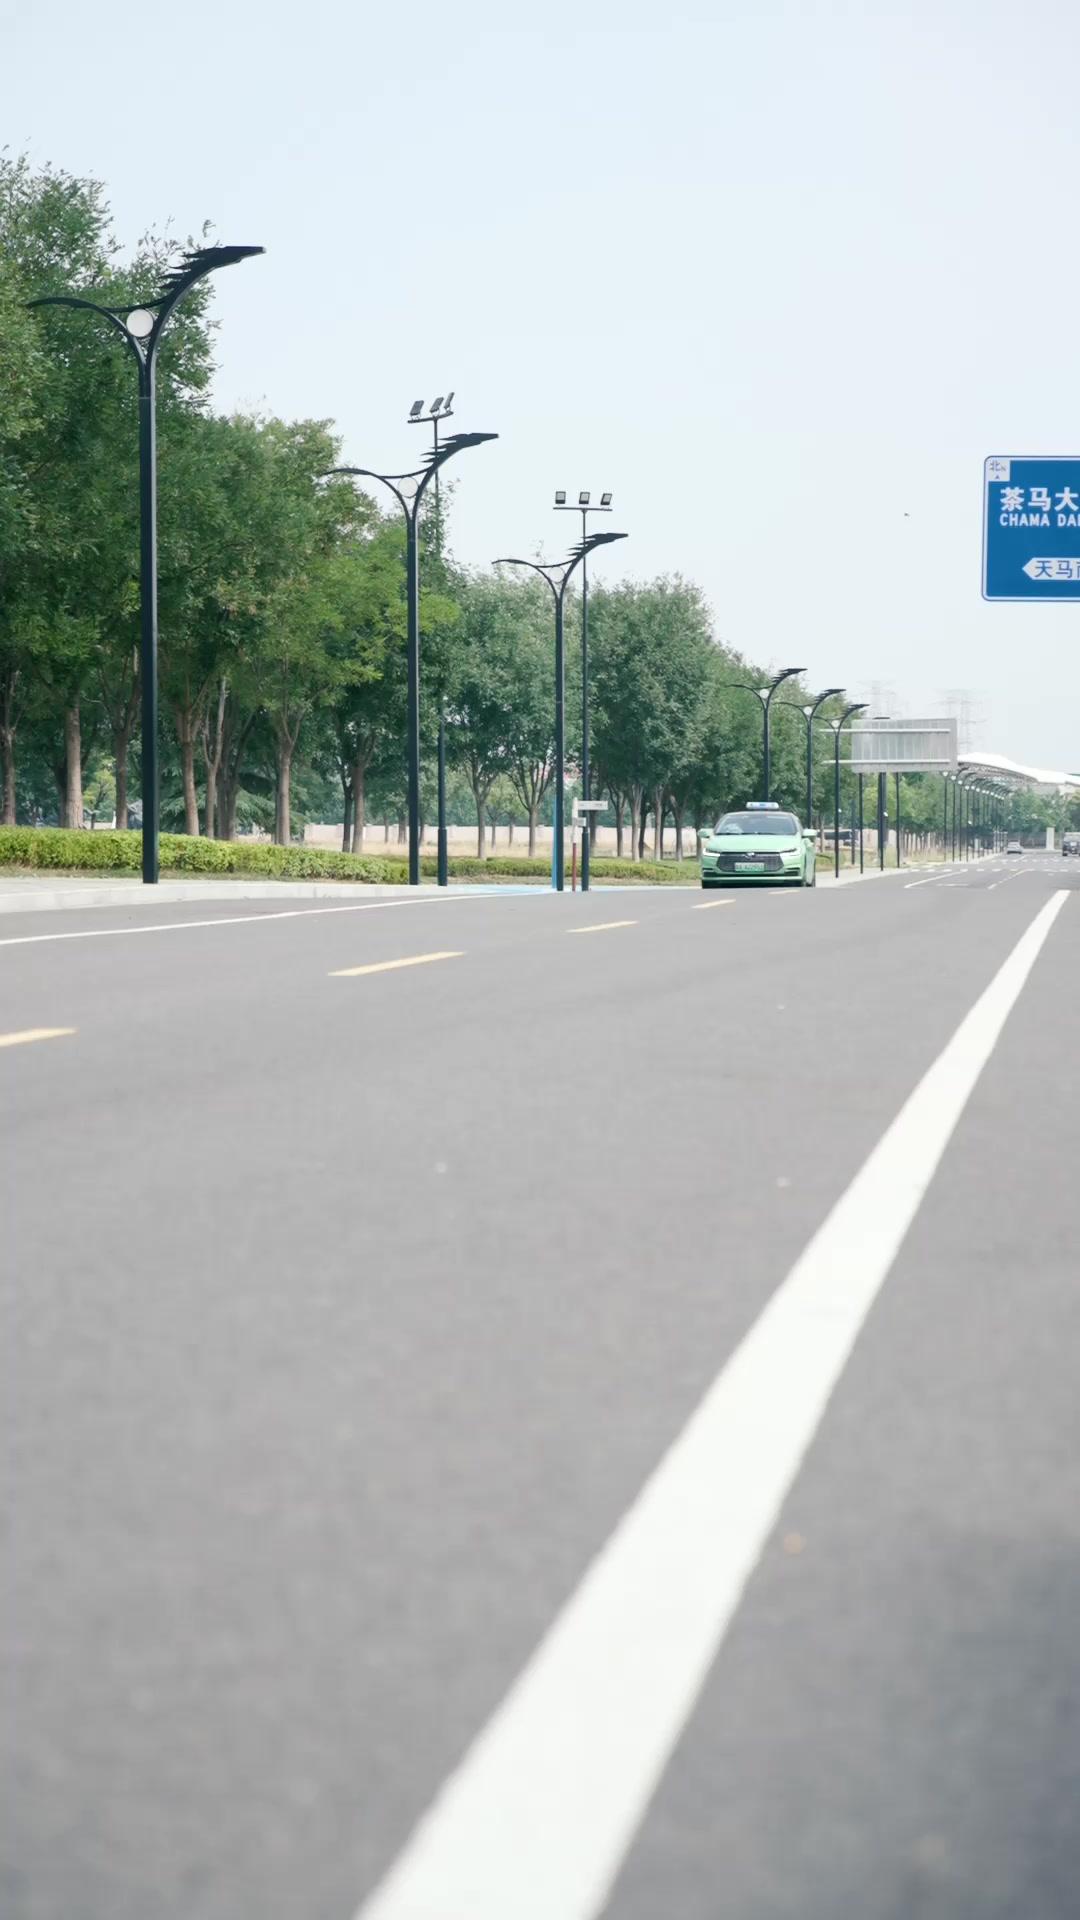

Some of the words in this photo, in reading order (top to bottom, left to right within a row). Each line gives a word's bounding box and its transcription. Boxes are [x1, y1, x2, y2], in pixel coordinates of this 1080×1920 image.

[1000, 487, 1079, 511] 茶马大
[1000, 513, 1050, 527] CHAMA
[1035, 560, 1080, 578] 天马
